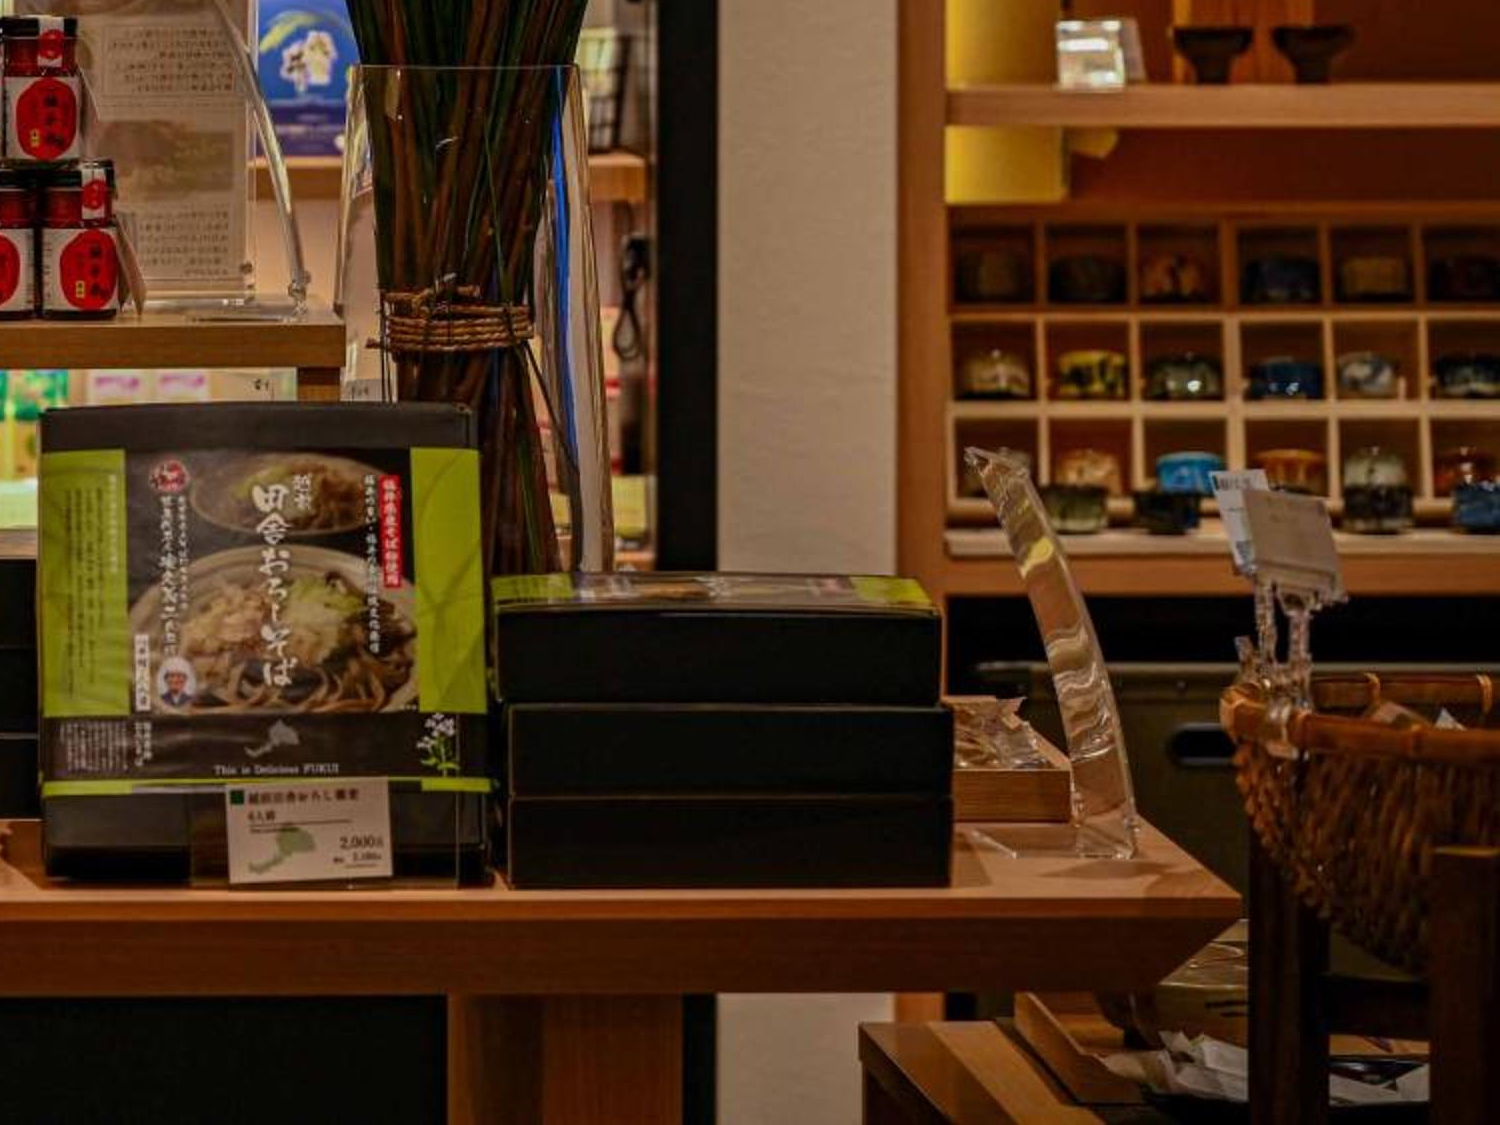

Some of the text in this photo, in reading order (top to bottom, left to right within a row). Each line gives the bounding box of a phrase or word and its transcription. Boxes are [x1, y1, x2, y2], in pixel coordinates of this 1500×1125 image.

[252, 483, 298, 688] 田舎おろしそば
[213, 764, 237, 775] This
[254, 764, 299, 774] Delicious
